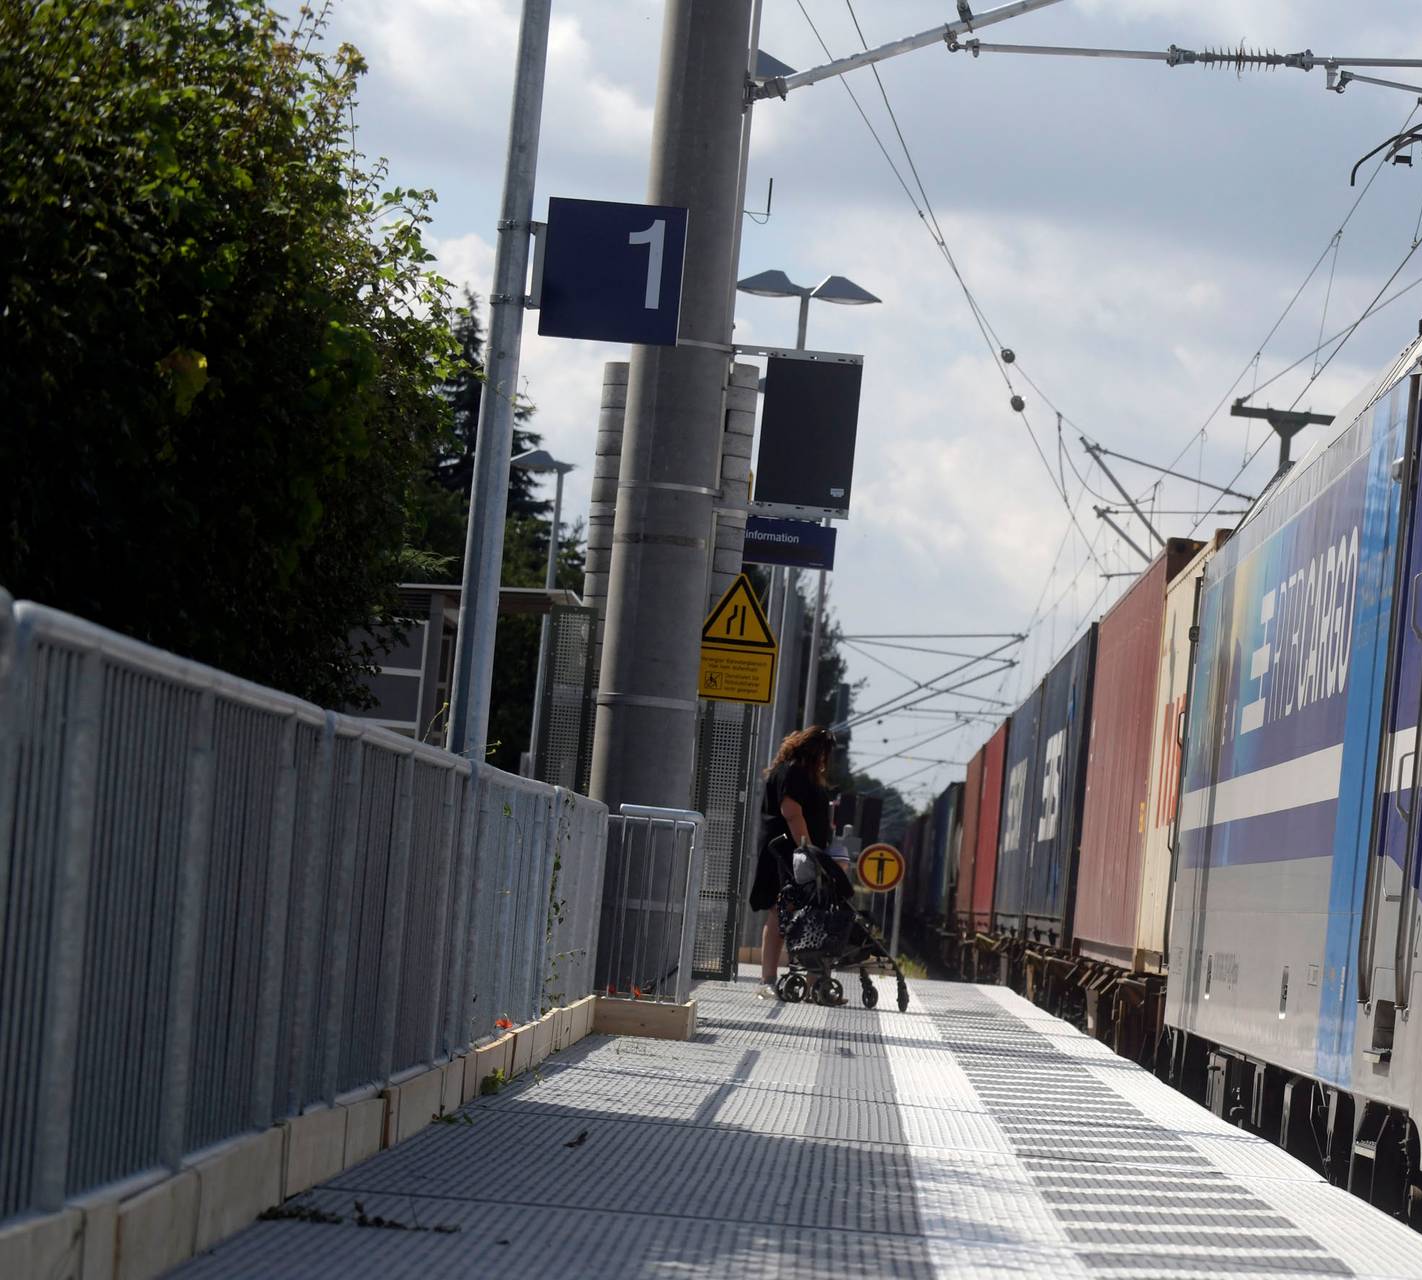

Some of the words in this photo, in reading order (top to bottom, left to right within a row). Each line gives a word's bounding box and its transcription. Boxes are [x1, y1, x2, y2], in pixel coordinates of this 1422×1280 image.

[629, 219, 666, 310] 1
[1267, 568, 1305, 724] RTB
[1296, 525, 1359, 712] CARGO
